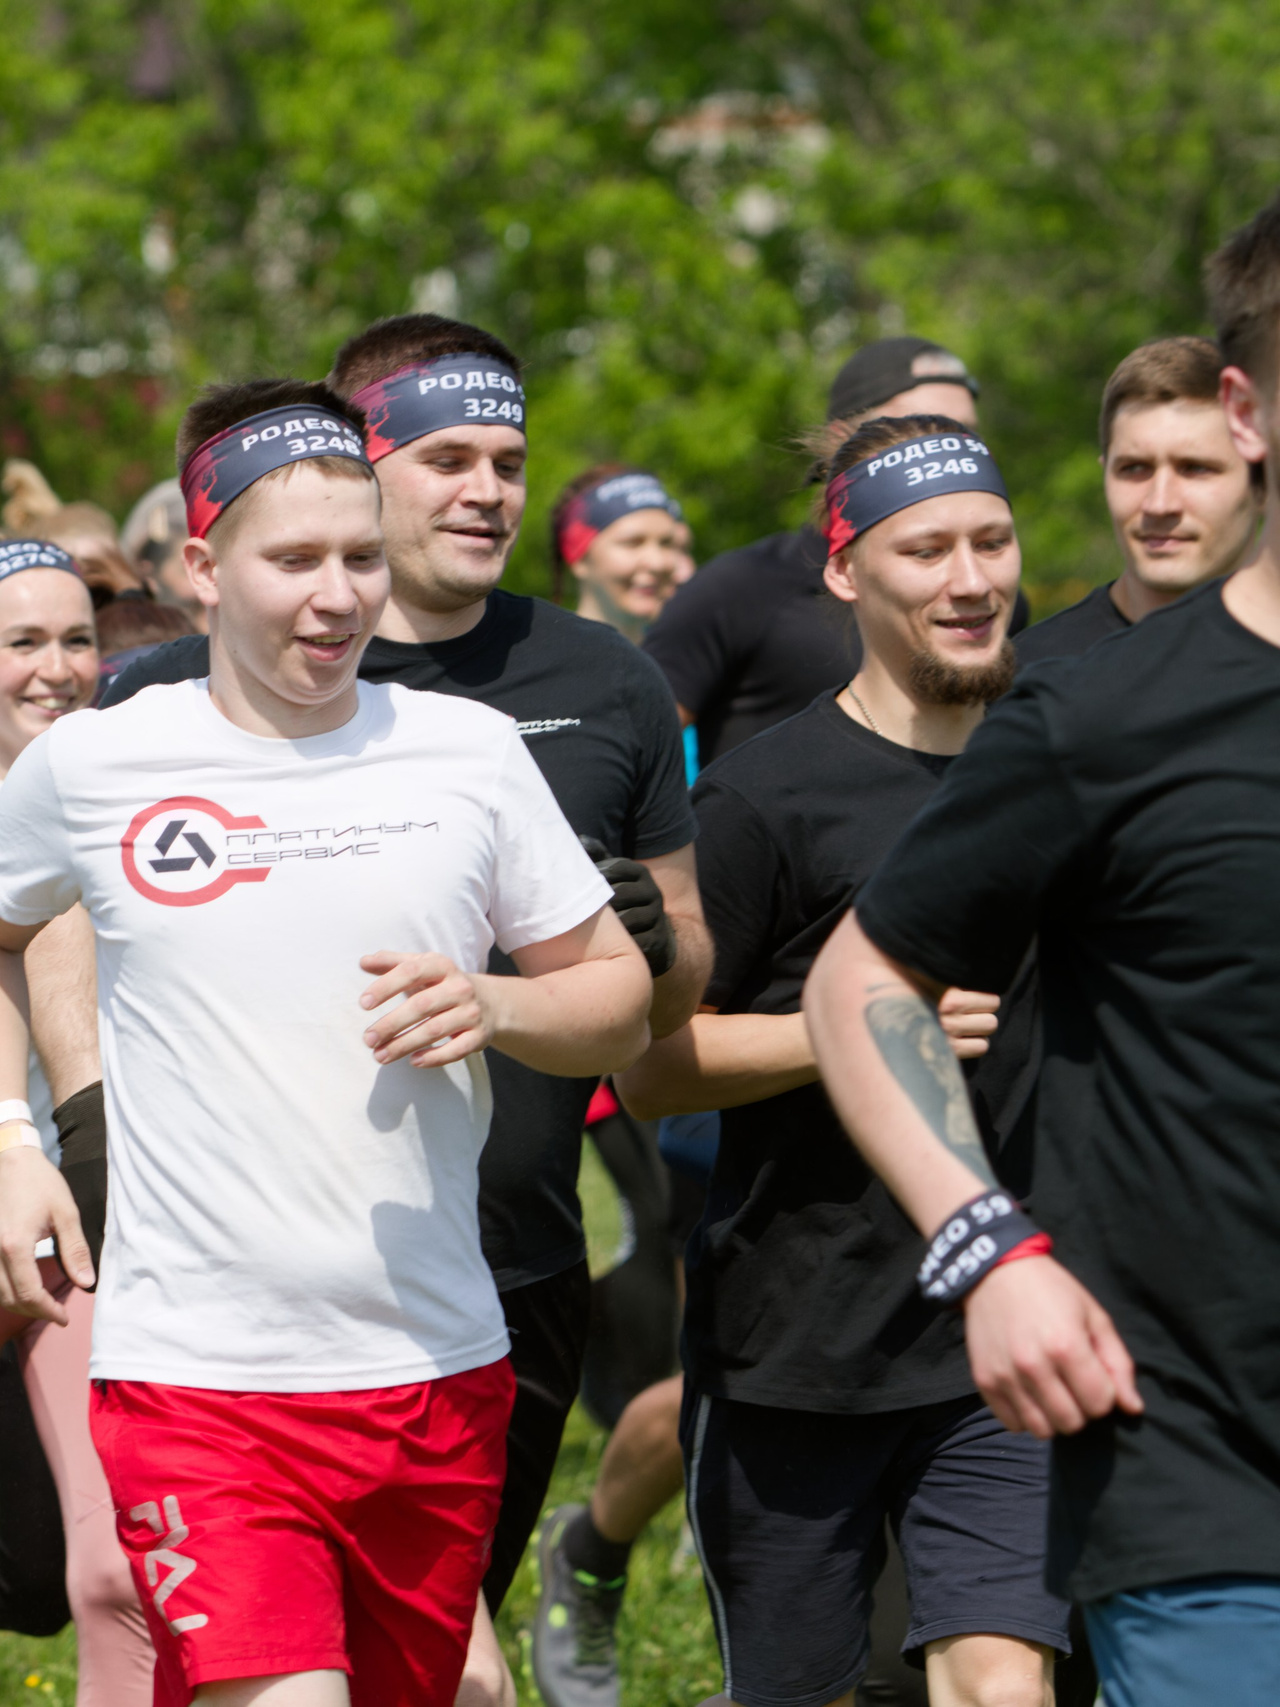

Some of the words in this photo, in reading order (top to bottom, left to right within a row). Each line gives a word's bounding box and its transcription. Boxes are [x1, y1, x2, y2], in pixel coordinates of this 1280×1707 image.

[418, 371, 517, 395] РОДЕО
[463, 398, 523, 423] 3249
[241, 418, 341, 452] РОДЕО
[286, 435, 361, 456] 3248
[867, 437, 961, 477] РОДЕО
[904, 457, 979, 486] 3246
[226, 821, 439, 847] ПЛАТИНУМ
[227, 842, 381, 865] СЕРВИС
[969, 1194, 1012, 1225] 59
